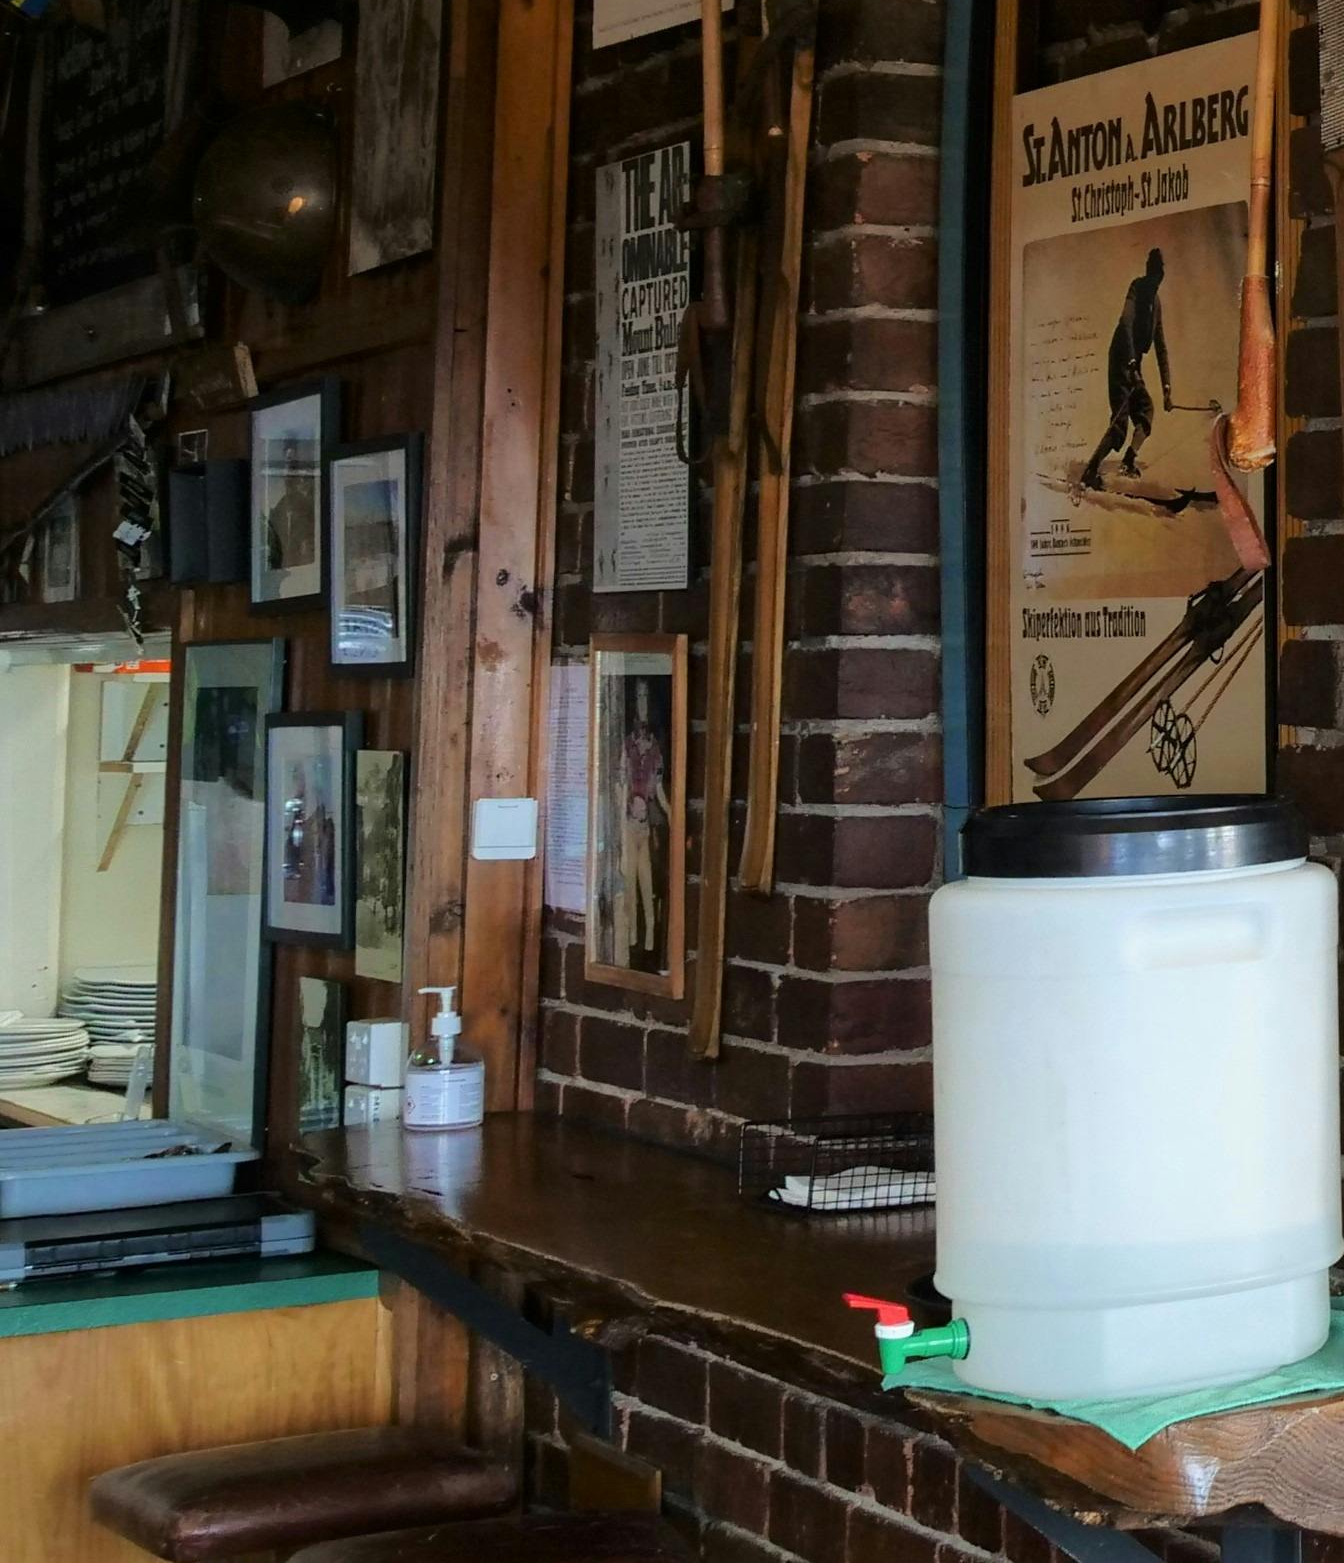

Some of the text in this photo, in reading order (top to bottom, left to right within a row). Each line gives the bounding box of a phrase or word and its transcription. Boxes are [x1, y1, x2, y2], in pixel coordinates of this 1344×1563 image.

[1140, 85, 1249, 159] ARLBERG
[622, 274, 690, 321] CAPTURED
[1022, 605, 1146, 641] Skiperfektion aus Tradition
